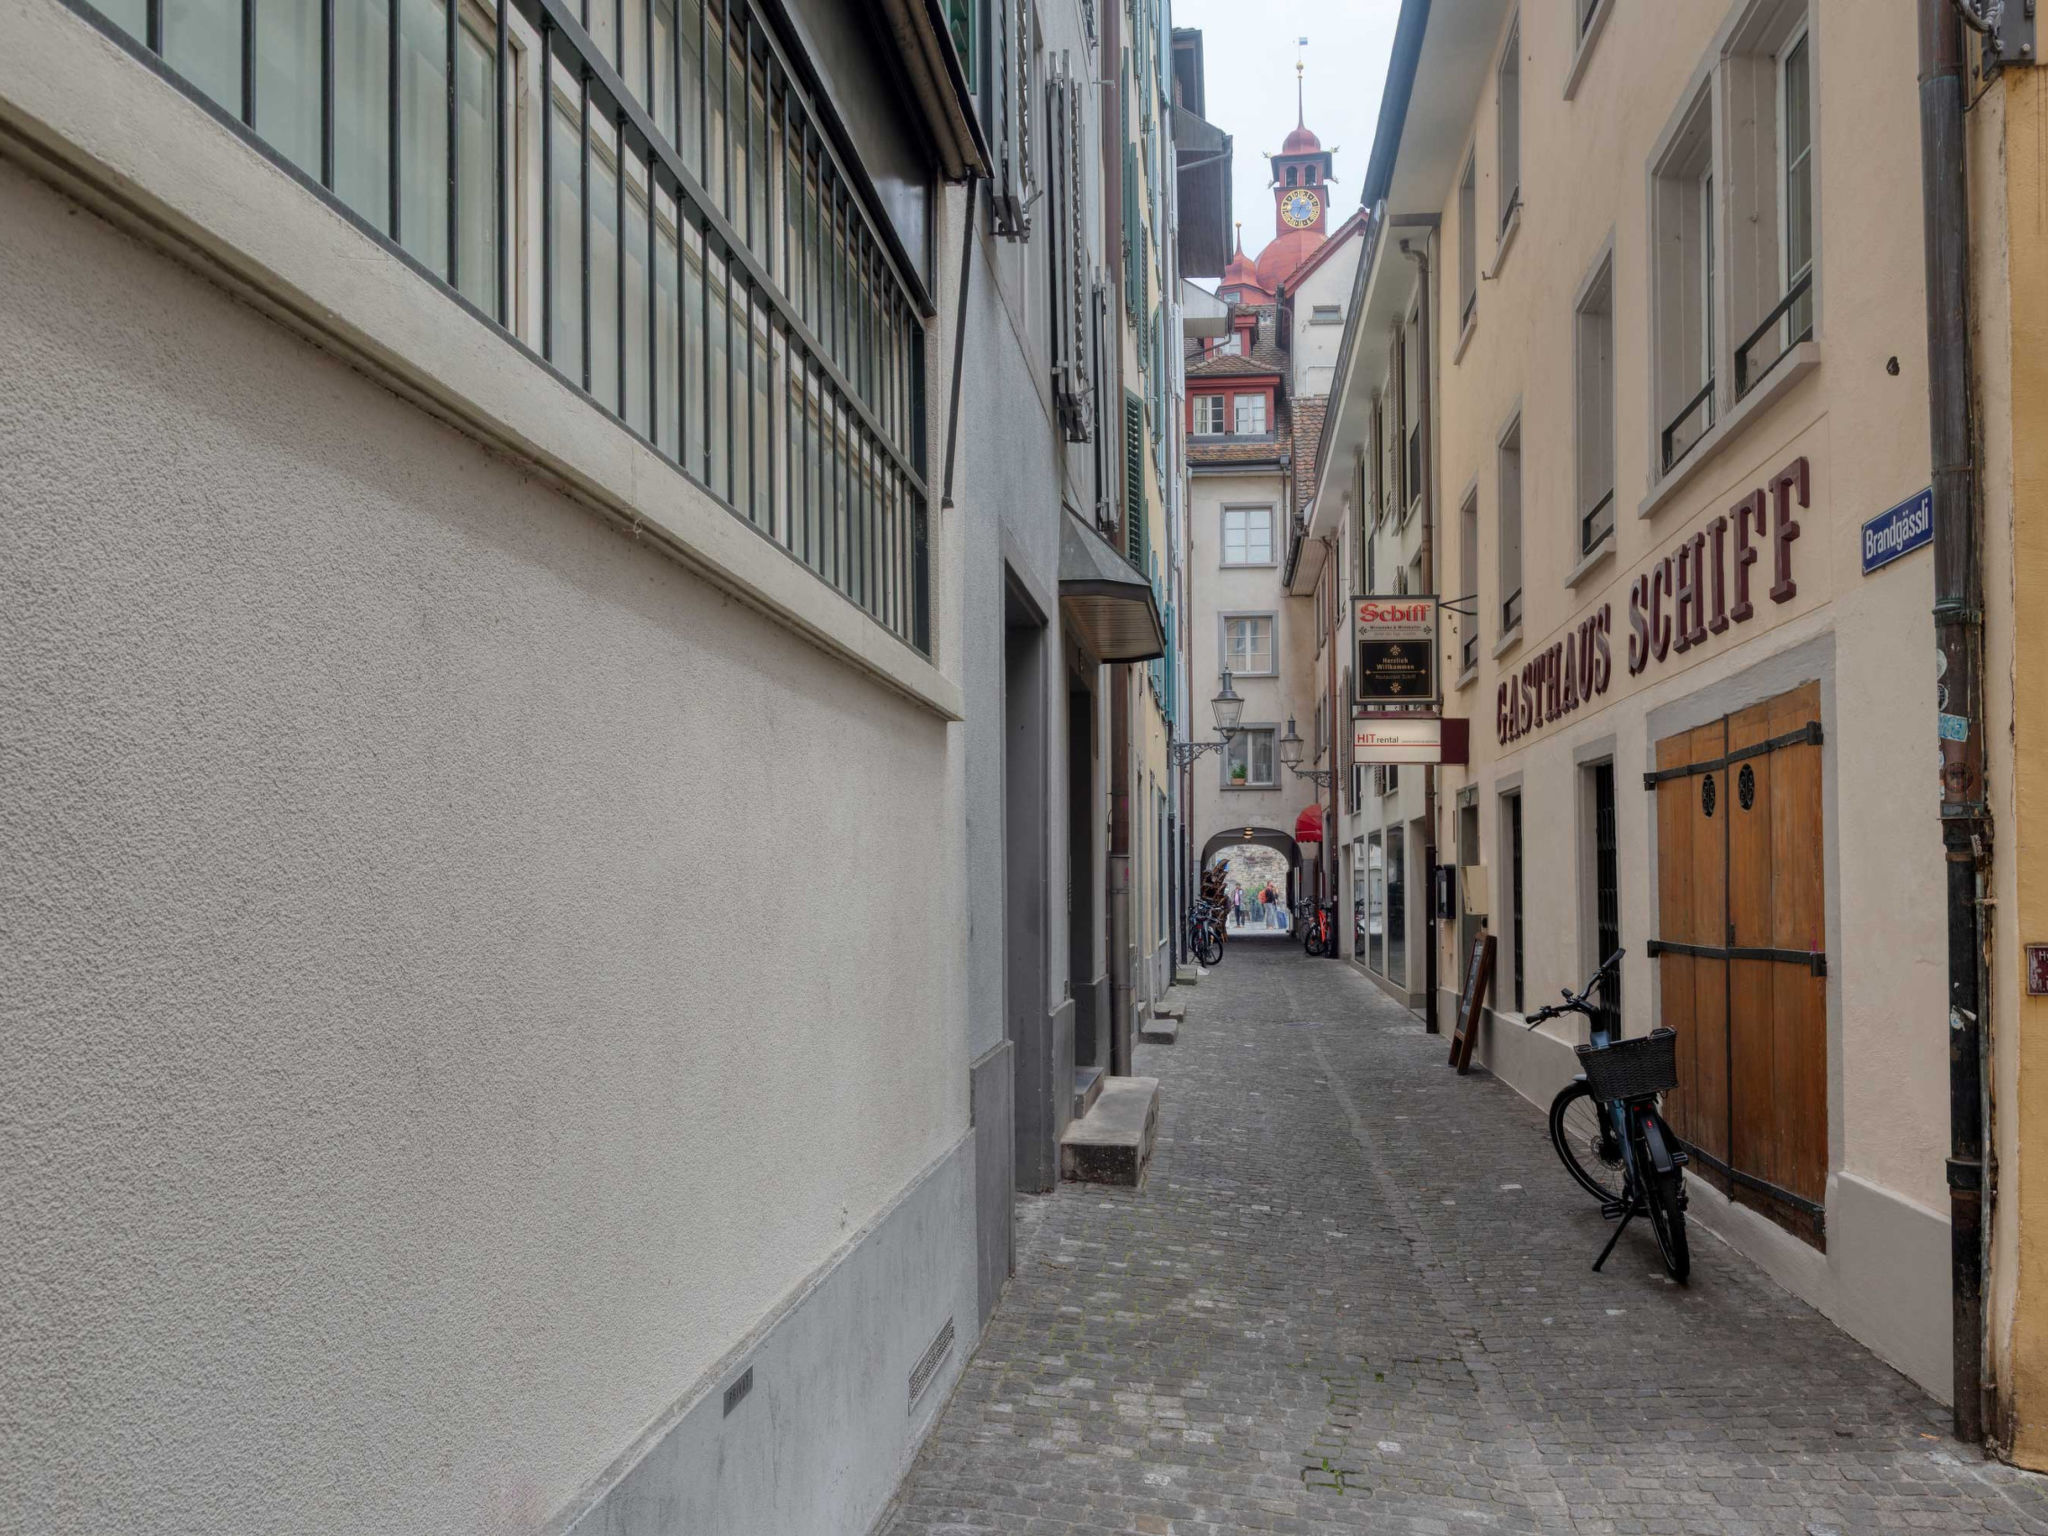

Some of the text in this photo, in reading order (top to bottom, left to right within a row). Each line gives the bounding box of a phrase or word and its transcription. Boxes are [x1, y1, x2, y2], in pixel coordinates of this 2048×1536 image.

[1866, 497, 1929, 560] Brandgässli
[1360, 603, 1432, 623] Schiff
[1497, 456, 1810, 745] GASTHAUS SCHIFF
[1357, 733, 1399, 744] HIT rental
